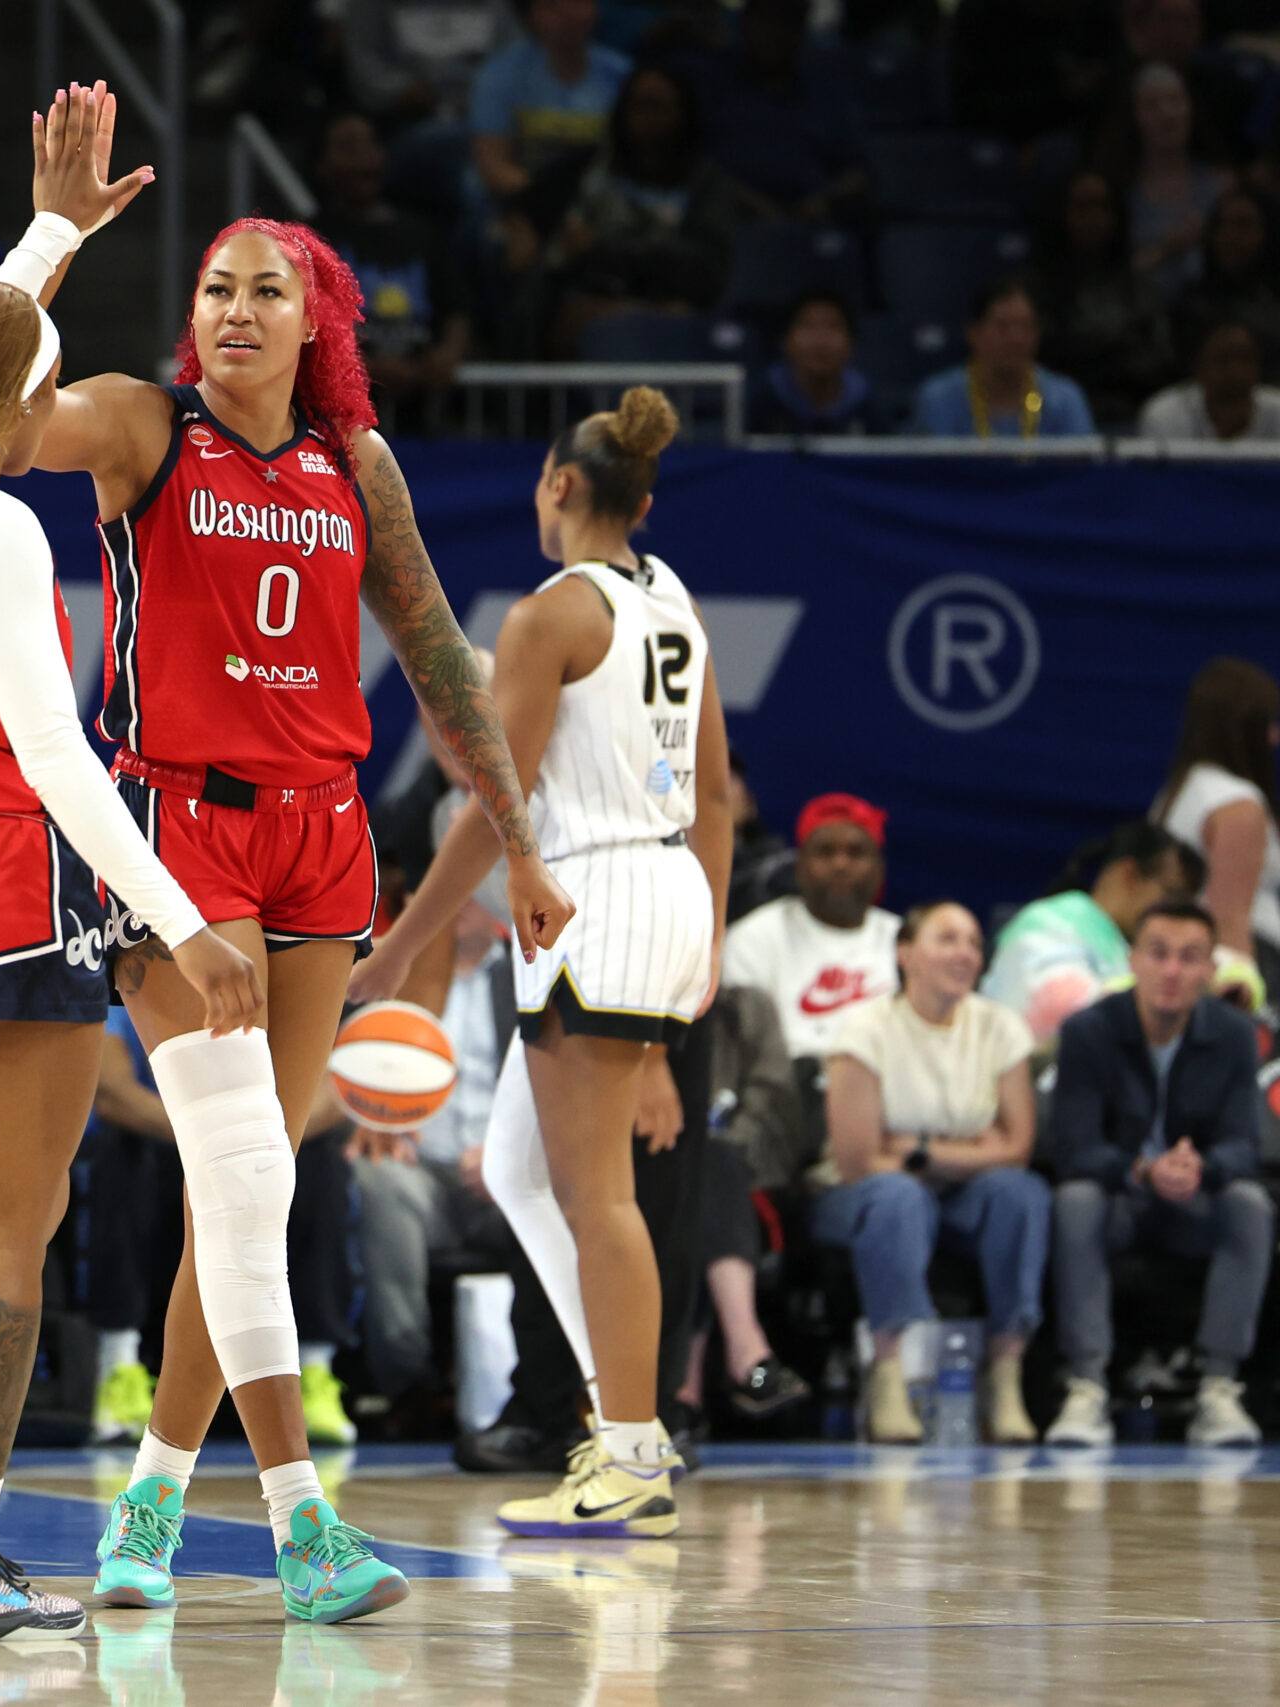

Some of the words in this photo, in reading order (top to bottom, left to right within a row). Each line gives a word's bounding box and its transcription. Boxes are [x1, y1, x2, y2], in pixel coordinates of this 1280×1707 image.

[297, 450, 327, 465] CAR
[300, 461, 337, 476] max
[189, 487, 355, 556] Washington
[256, 564, 300, 637] 0
[252, 665, 319, 682] ANDA
[642, 631, 692, 706] 12
[651, 717, 688, 750] YLOR
